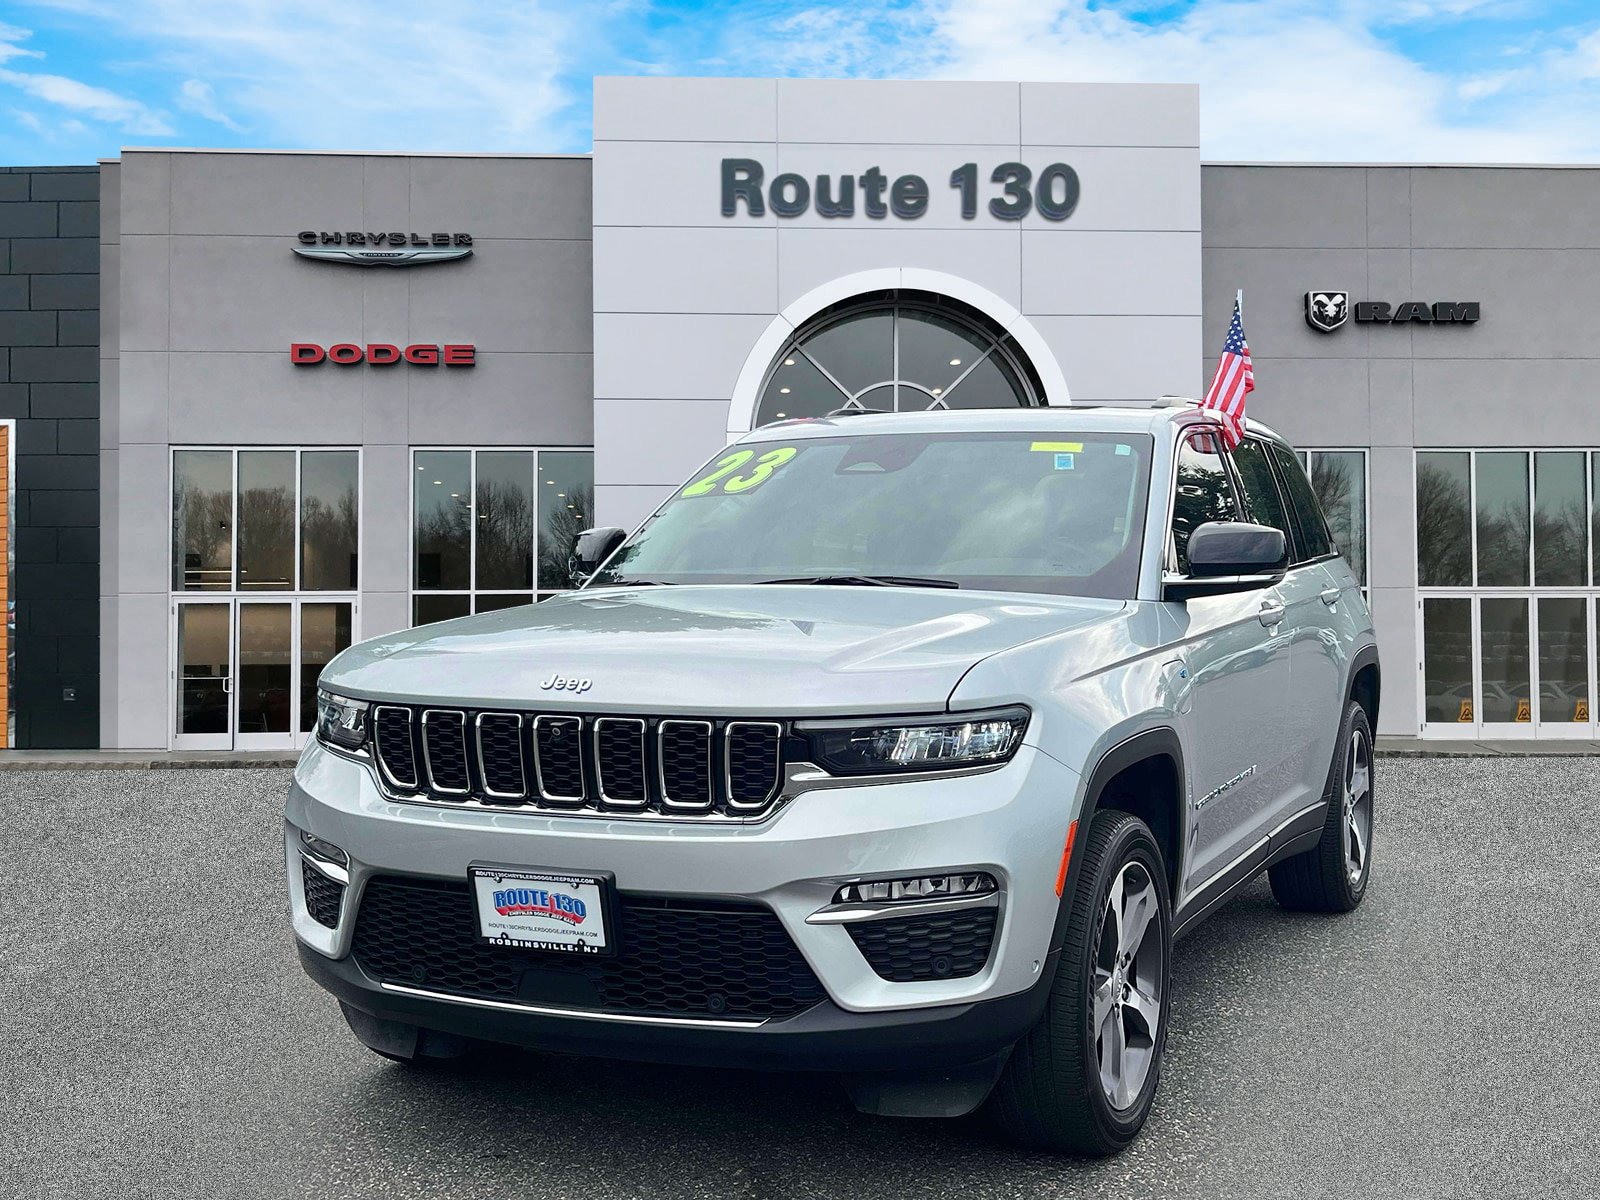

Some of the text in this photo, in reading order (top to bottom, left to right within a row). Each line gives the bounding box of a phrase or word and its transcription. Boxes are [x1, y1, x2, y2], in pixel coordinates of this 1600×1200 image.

[721, 158, 1080, 221] Route 130
[298, 231, 473, 246] CHRYSLER
[1354, 302, 1481, 324] RAM
[291, 343, 476, 366] DODGE
[681, 447, 797, 499] 23
[540, 673, 593, 694] Jeep
[494, 888, 587, 918] ROUTE 130
[488, 938, 598, 954] ROBBINSVILLE, NJ
